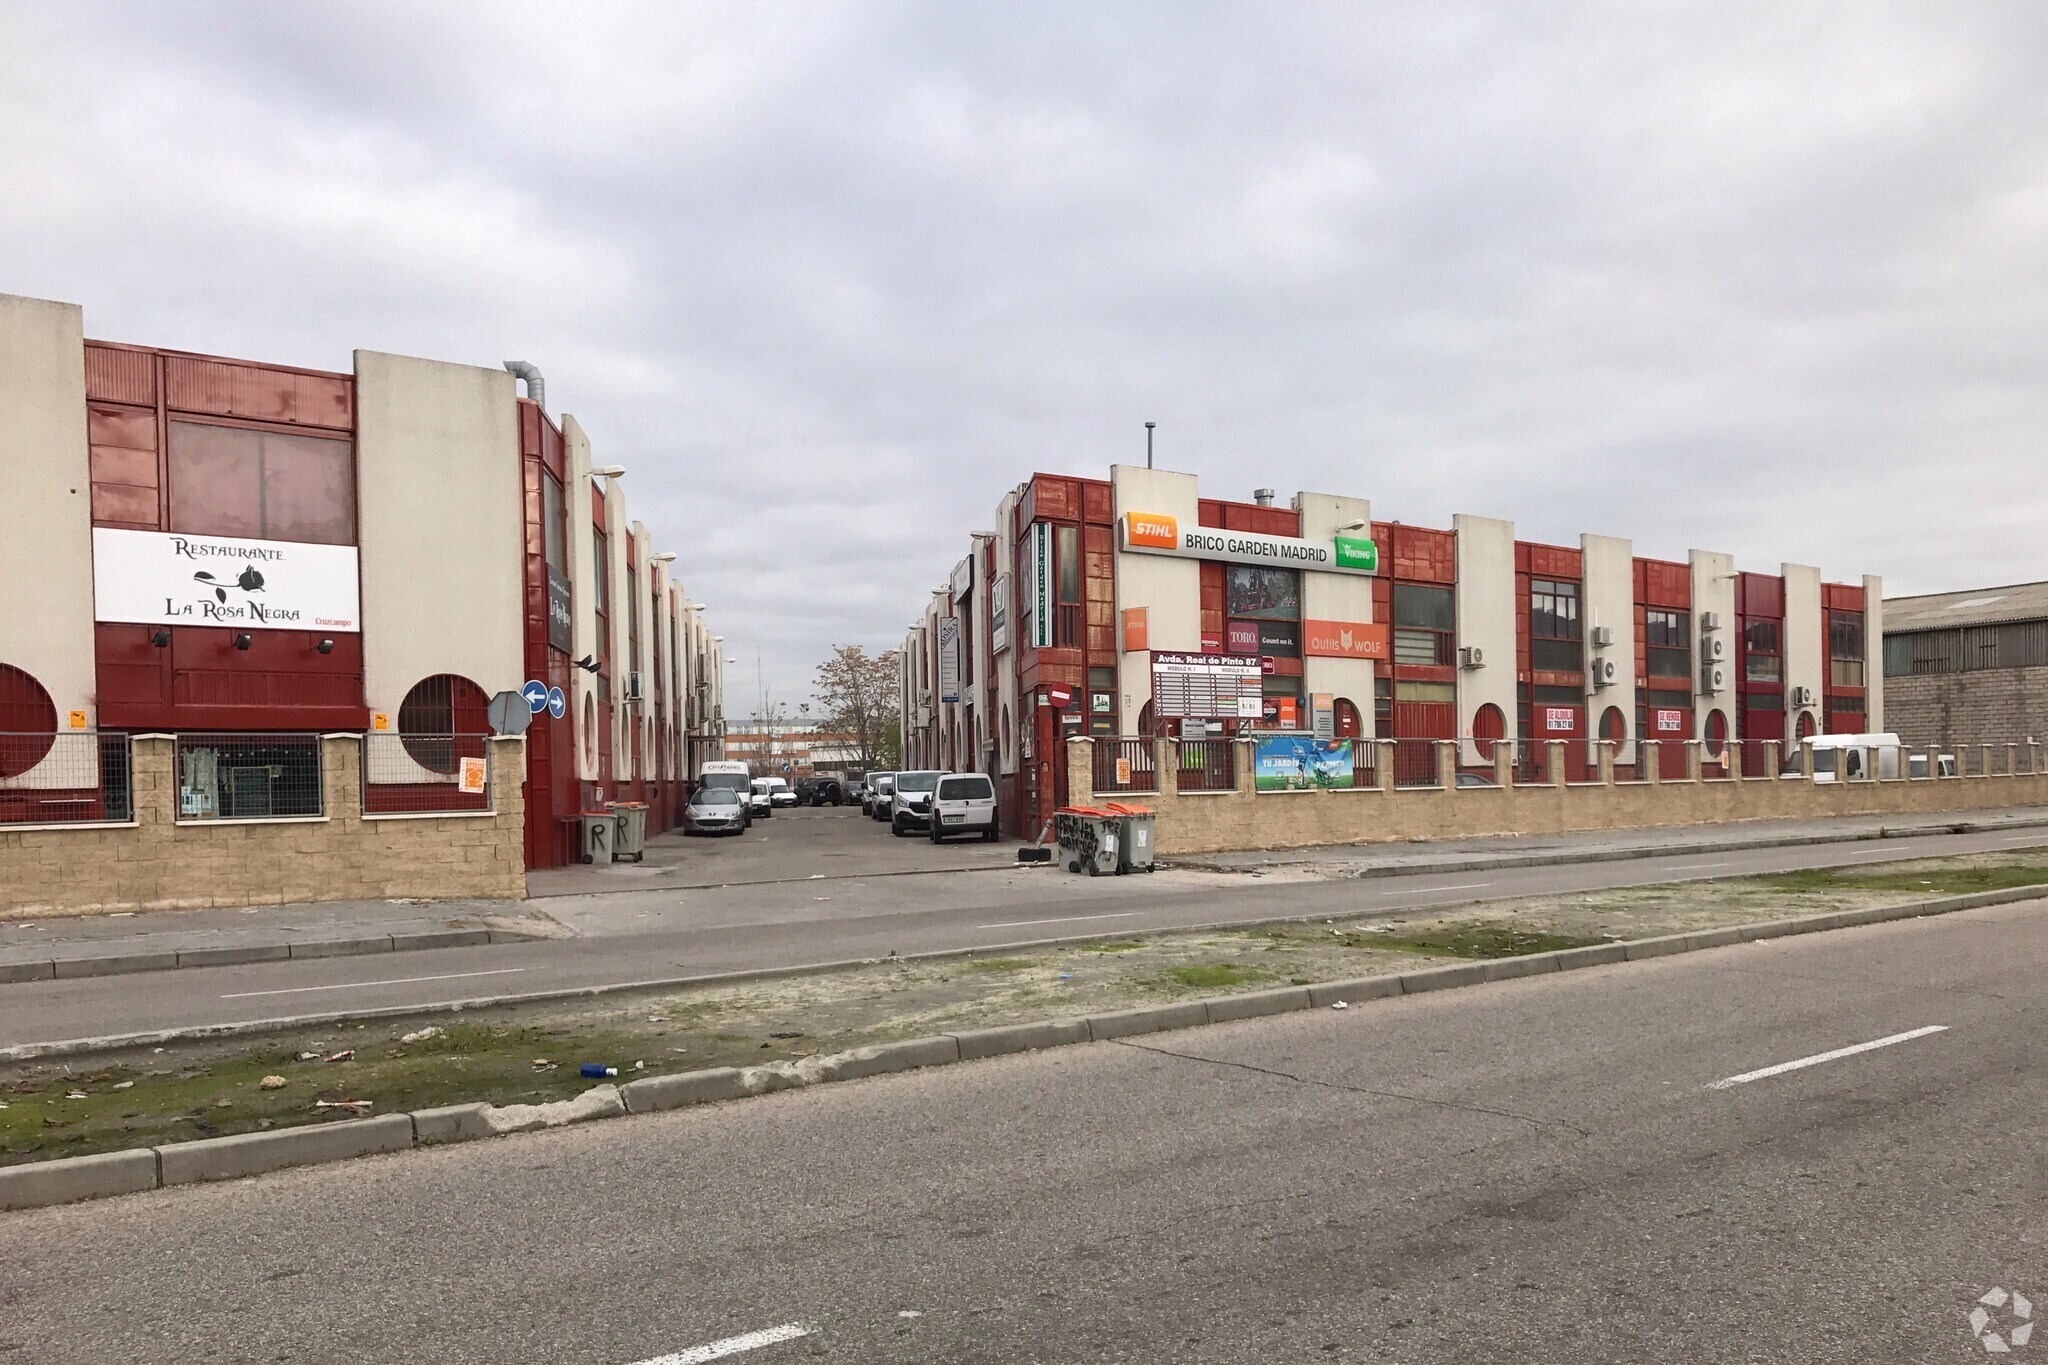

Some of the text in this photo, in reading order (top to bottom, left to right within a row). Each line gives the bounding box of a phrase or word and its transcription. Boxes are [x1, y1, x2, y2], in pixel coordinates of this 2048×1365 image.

[1135, 522, 1174, 539] STIHL
[170, 537, 285, 562] RESTAURANTE
[1186, 534, 1327, 563] BRICO GARDEN MADRID
[1345, 548, 1371, 560] VIKING
[165, 598, 300, 623] LA ROSA NEGRA
[315, 617, 351, 627] Cruzcampo
[1127, 621, 1146, 629] STIHL
[1231, 632, 1256, 643] TORO
[1262, 637, 1279, 645] Count
[1311, 637, 1380, 652] Outils WOLF
[1158, 655, 1184, 664] Avda.
[1186, 656, 1206, 664] Real
[1208, 657, 1220, 665] de
[1221, 658, 1243, 666] Pinto
[1548, 710, 1573, 719] SE ALQUILA
[1659, 711, 1680, 721] SE VENDE
[617, 815, 628, 844] R
[591, 824, 605, 850] R
